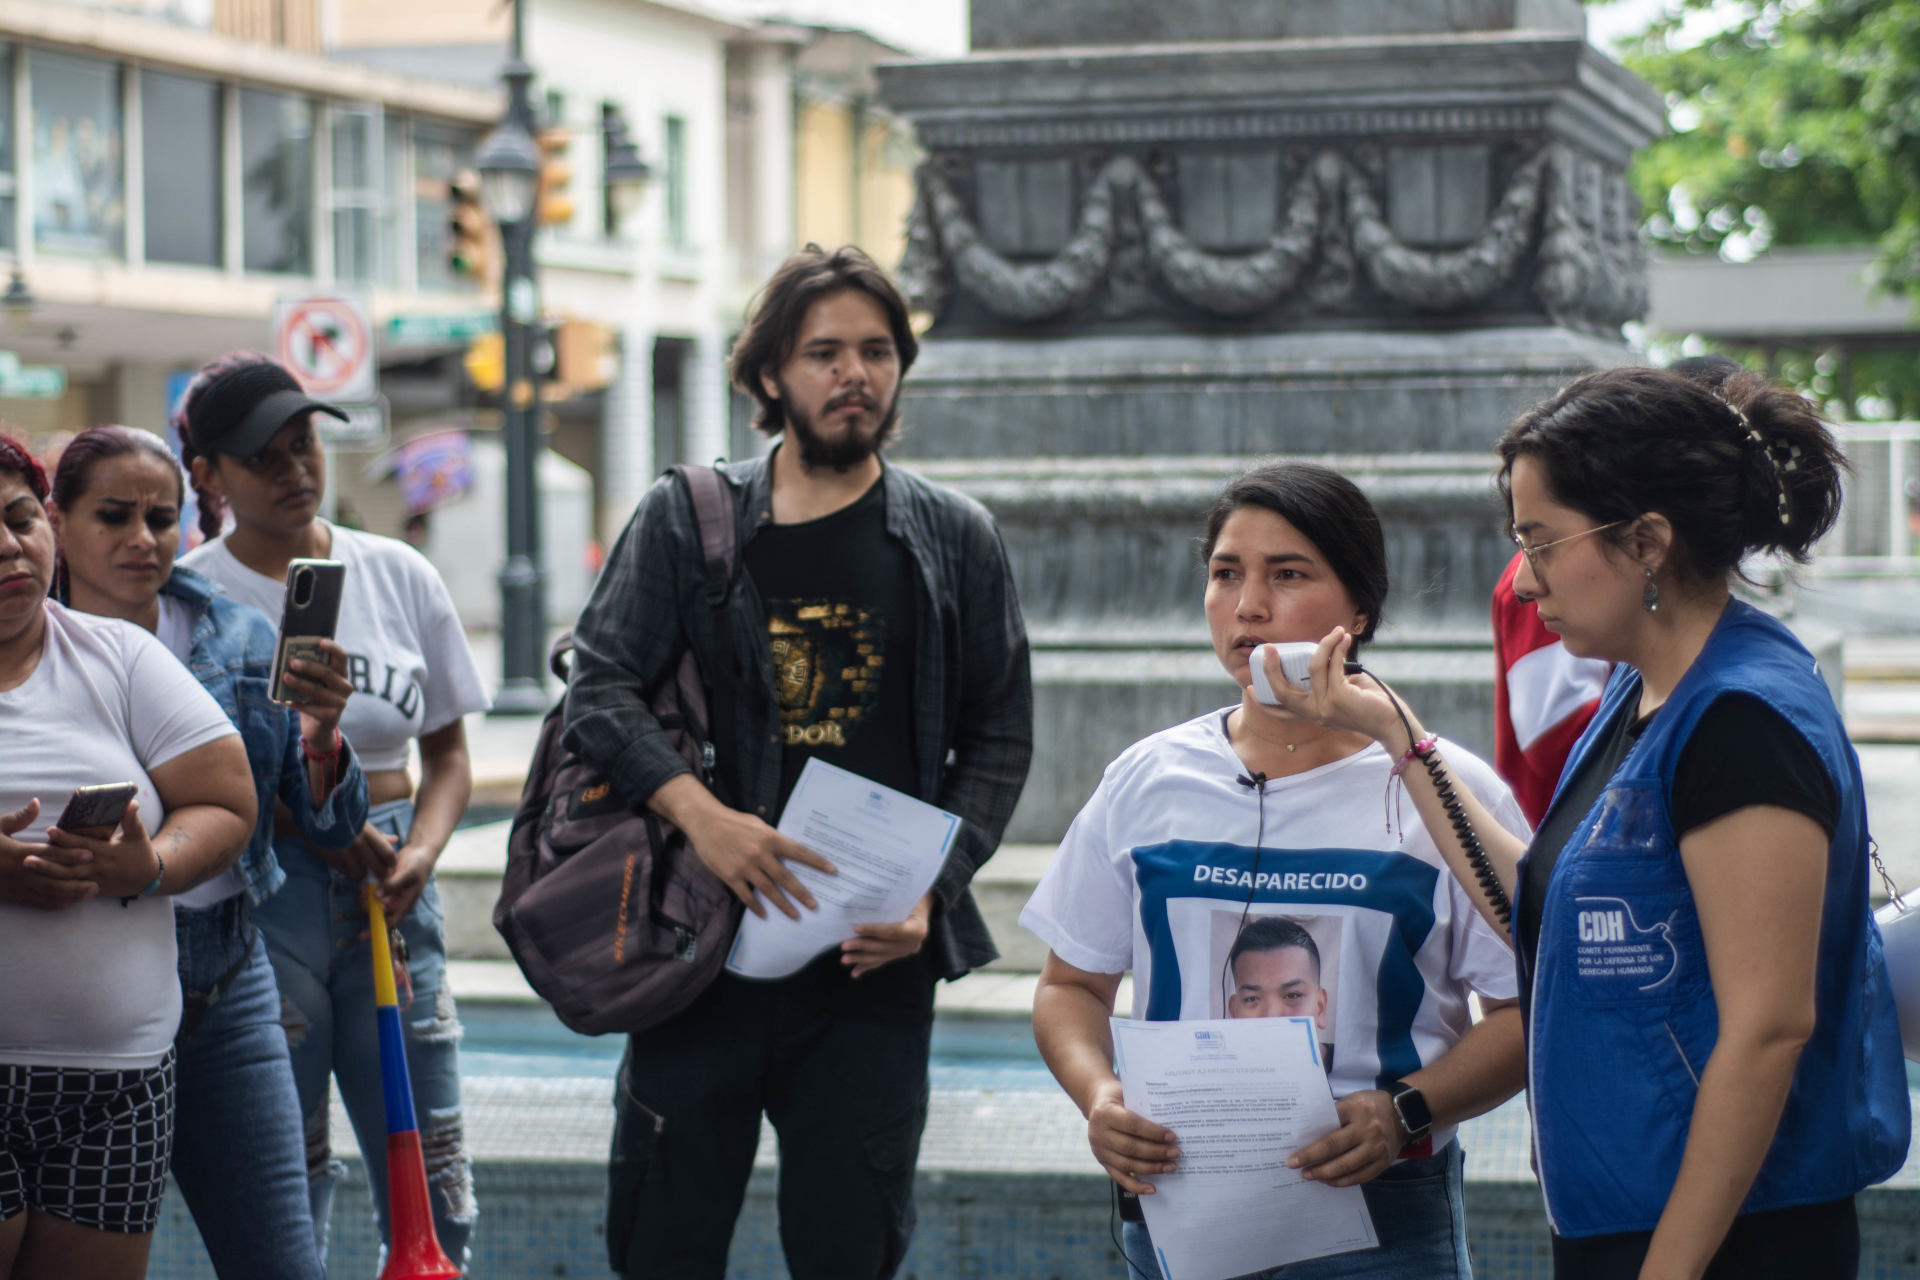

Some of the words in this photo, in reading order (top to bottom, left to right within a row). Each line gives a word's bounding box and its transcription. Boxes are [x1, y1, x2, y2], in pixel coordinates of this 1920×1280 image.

[1193, 864, 1367, 890] DESAPARECIDO
[1578, 911, 1625, 942] CDH
[1577, 946, 1602, 954] COMITE
[1604, 944, 1651, 954] PERMANENTE
[1578, 957, 1592, 965] POR
[1593, 956, 1602, 964] LA
[1604, 955, 1635, 964] DEFENSA
[1637, 954, 1648, 963] DE
[1650, 953, 1664, 962] LOS
[1579, 967, 1615, 976] DERECHOS
[1617, 965, 1654, 975] HUMANOS
